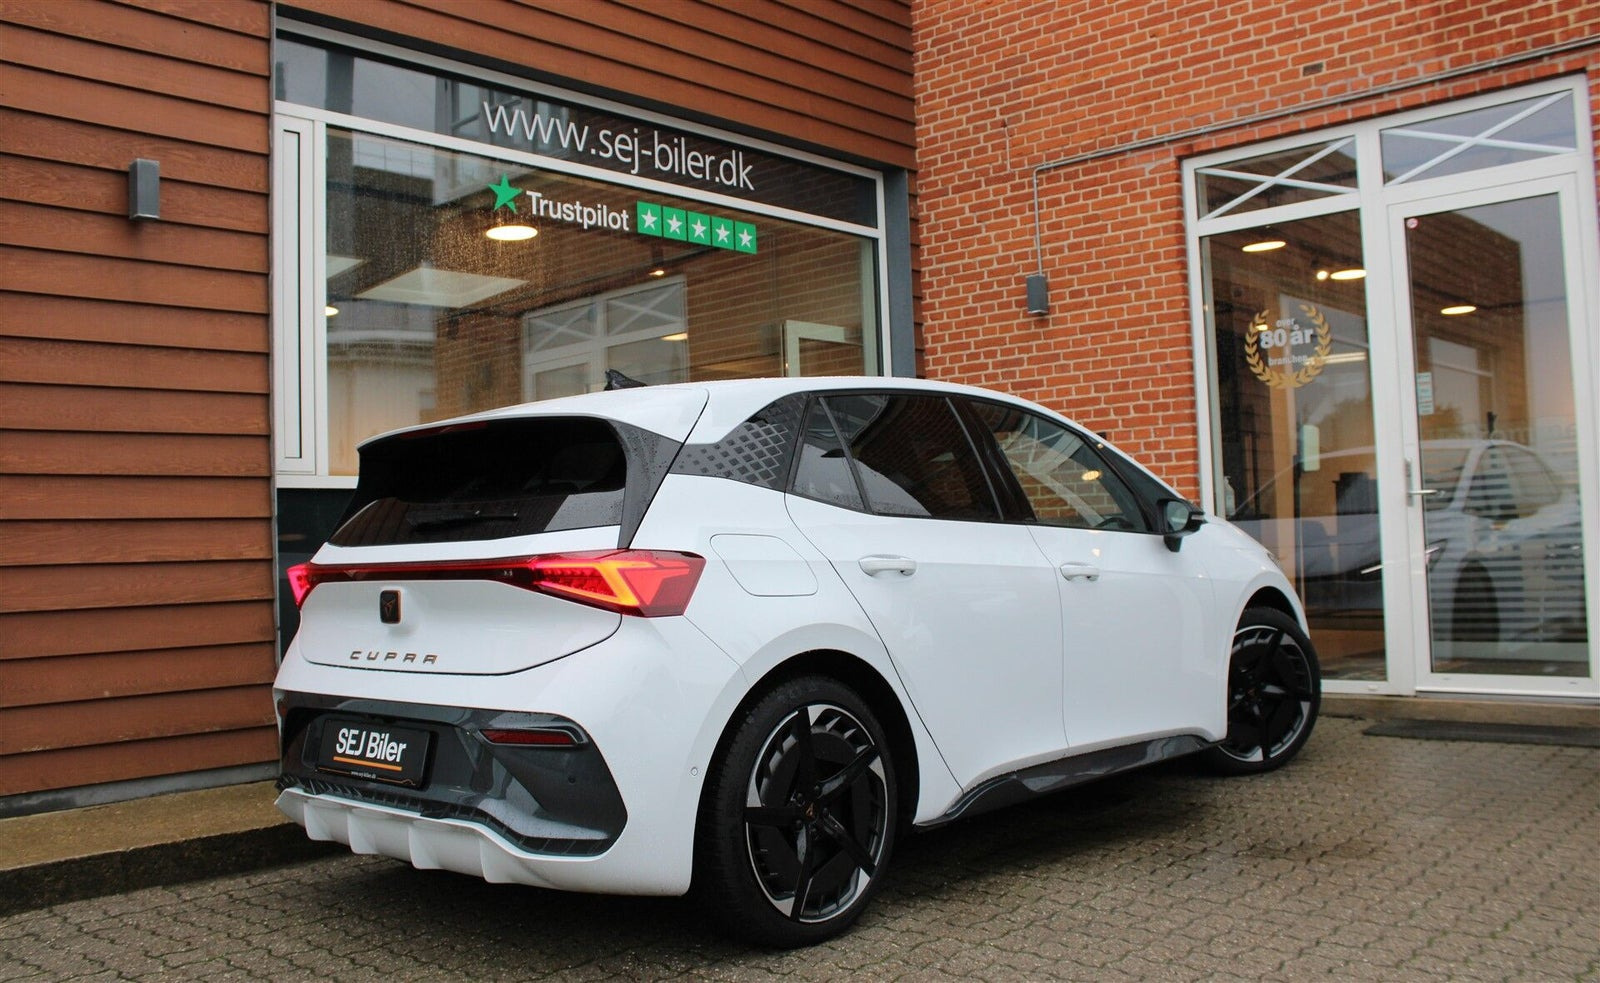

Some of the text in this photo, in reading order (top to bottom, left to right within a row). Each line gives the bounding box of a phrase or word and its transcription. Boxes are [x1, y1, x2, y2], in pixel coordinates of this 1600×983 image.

[483, 101, 755, 191] www.sej-biler.dk
[526, 190, 630, 231] Trustpilot
[1260, 324, 1314, 349] 80 år
[1276, 318, 1296, 328] over
[350, 651, 438, 664] CUPRA
[336, 728, 407, 762] SEJ Biler
